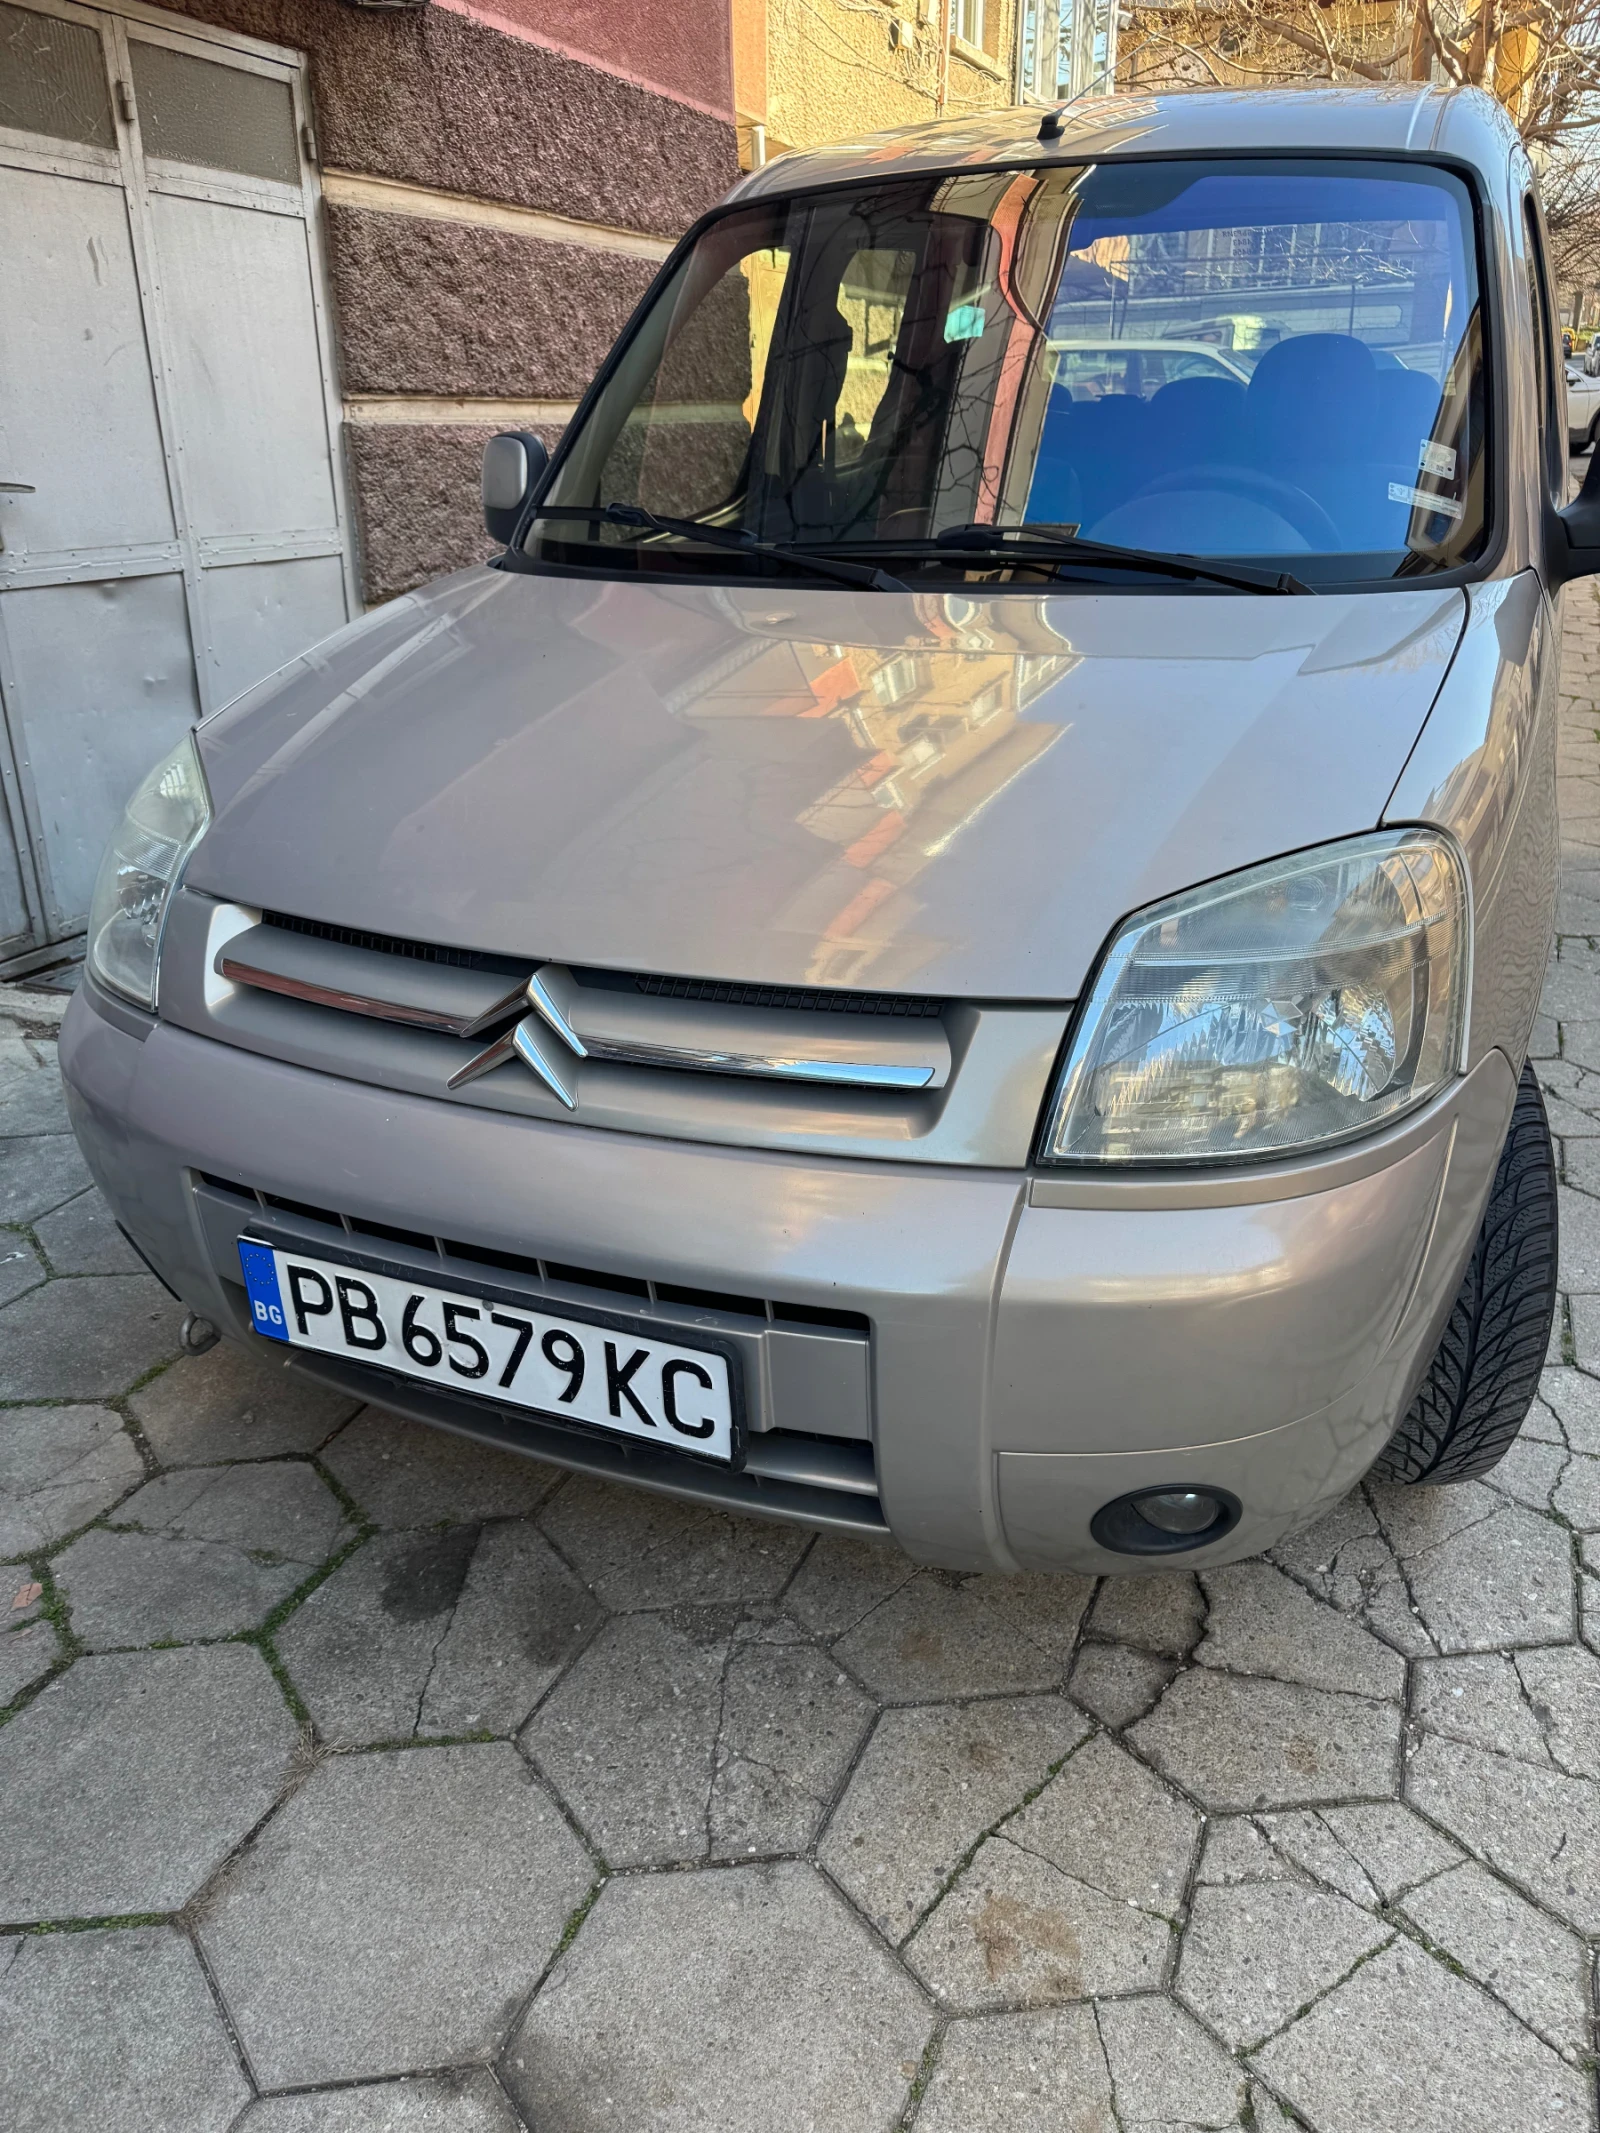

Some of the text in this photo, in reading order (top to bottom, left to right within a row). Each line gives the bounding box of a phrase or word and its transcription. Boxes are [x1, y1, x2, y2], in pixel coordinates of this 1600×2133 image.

[253, 1299, 283, 1325] BG
[286, 1263, 717, 1440] PB 6579 KC
